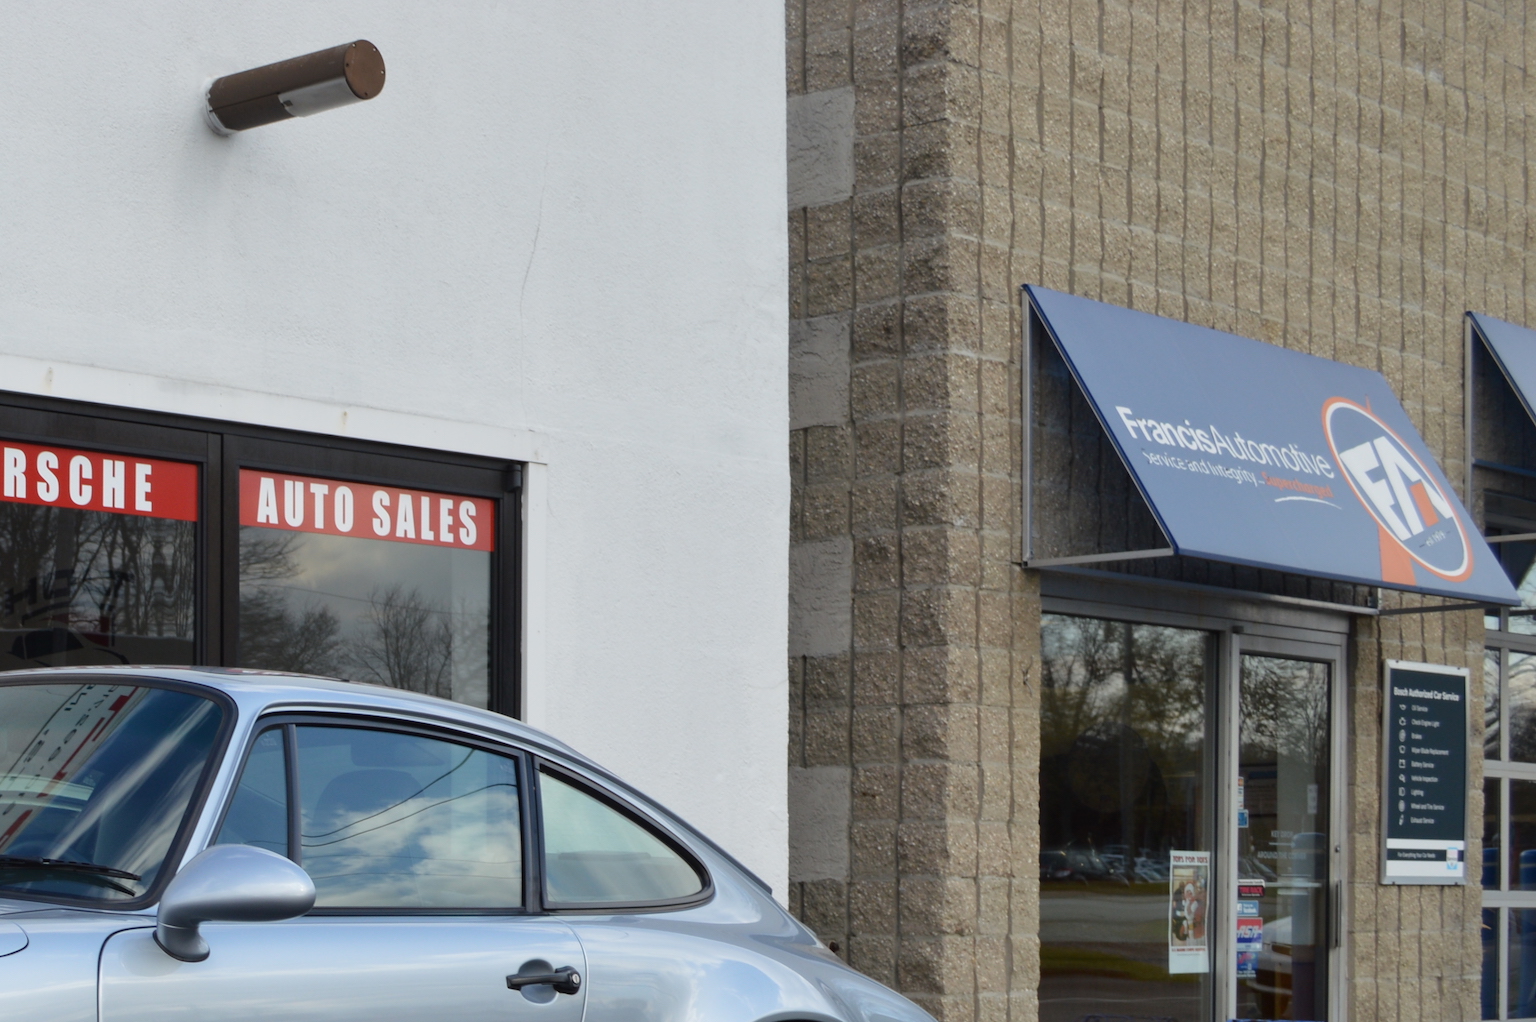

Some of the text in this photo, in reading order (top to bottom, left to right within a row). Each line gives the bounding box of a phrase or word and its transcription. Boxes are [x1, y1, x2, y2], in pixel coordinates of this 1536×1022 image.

[1187, 459, 1210, 474] and
[1261, 471, 1335, 499] Supercharged
[257, 477, 478, 545] AUTO SALES
[1393, 686, 1460, 702] Bosch Authorized Car Service
